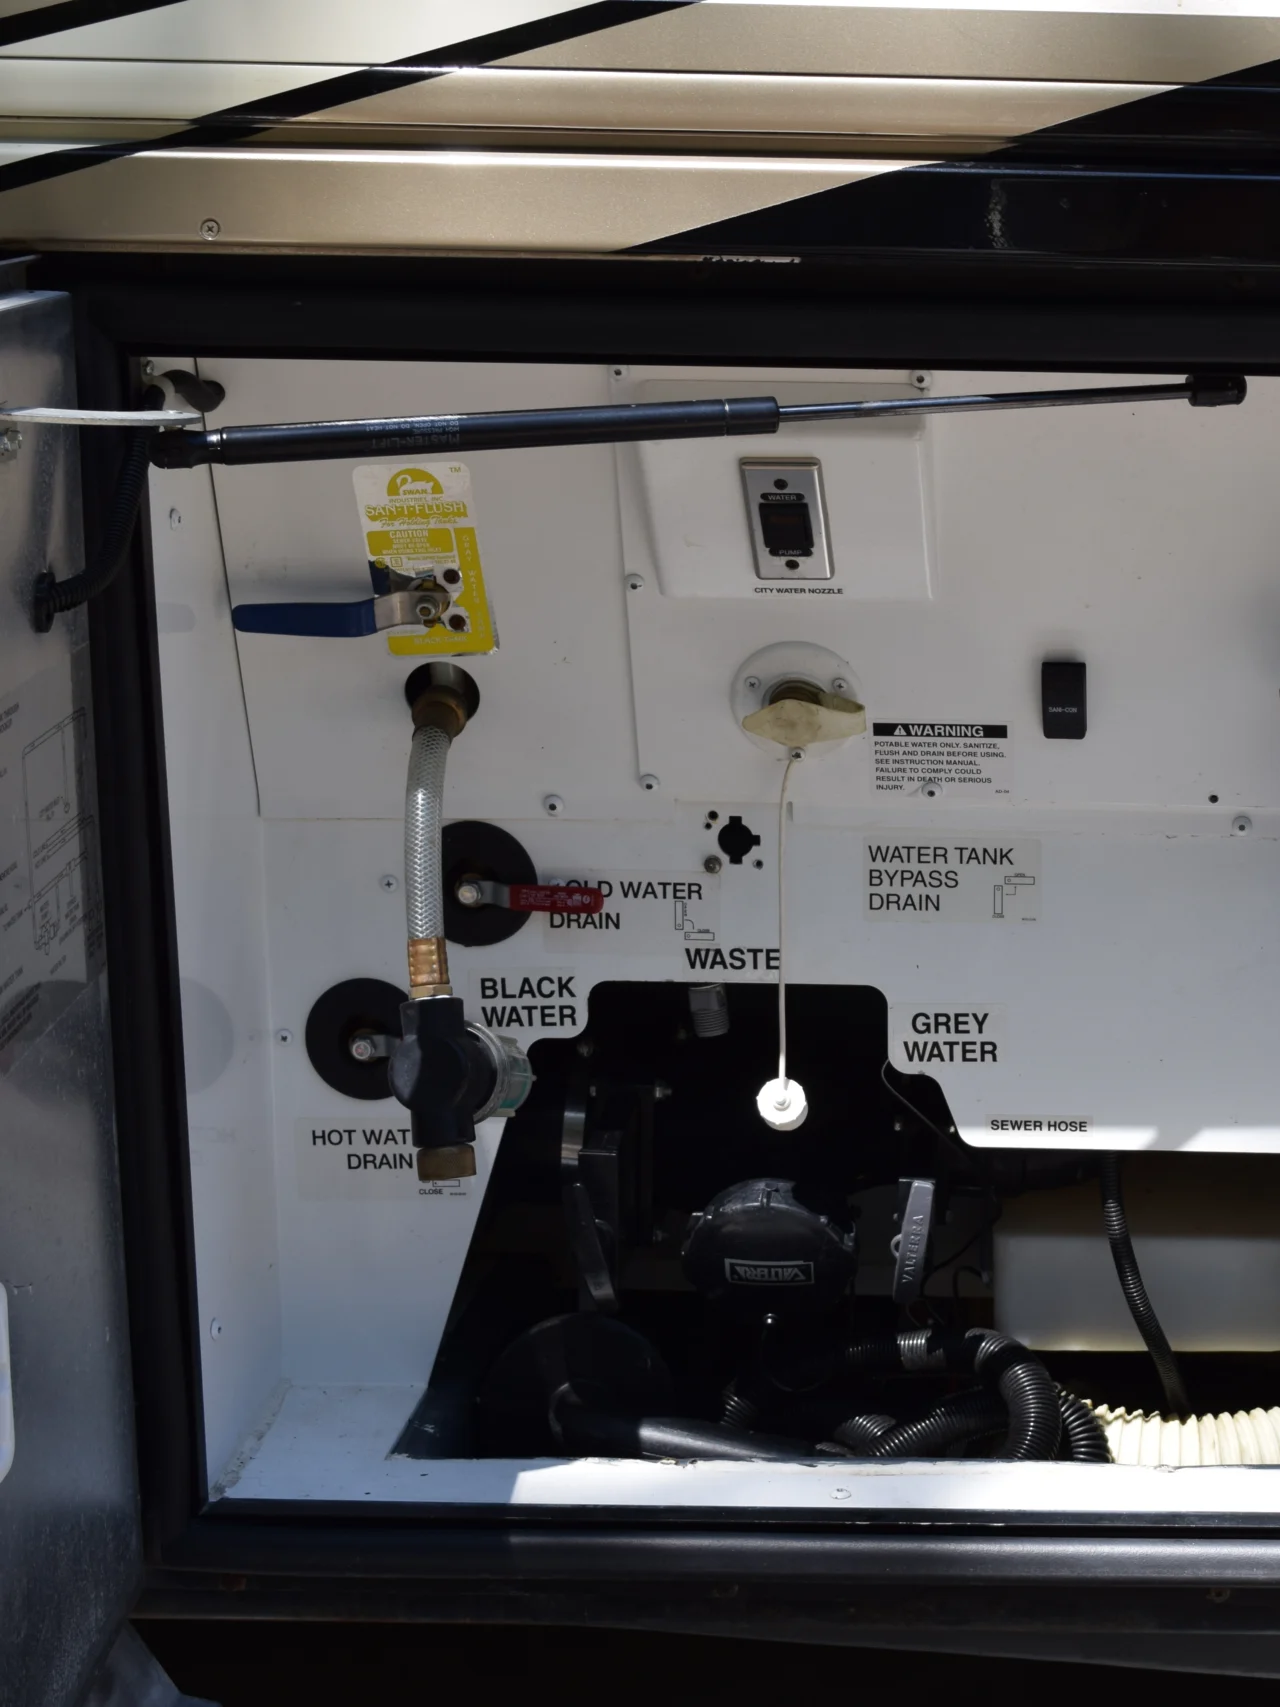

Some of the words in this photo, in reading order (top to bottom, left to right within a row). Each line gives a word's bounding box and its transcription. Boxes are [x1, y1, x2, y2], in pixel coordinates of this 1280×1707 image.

[402, 488, 428, 496] SWAN
[389, 529, 429, 539] CAUTION
[807, 588, 844, 596] NOZZLE
[908, 725, 984, 737] WARNING
[910, 741, 938, 749] WATER
[868, 845, 949, 864] WATER
[954, 847, 1014, 866] TANK
[869, 869, 959, 889] BYPASS
[619, 880, 703, 901] WATER
[869, 893, 940, 912] DRAIN
[550, 912, 620, 930] DRAIN
[685, 948, 780, 970] WASTE
[480, 976, 577, 999] BLACK
[481, 1005, 577, 1028] WATER
[911, 1012, 989, 1035] GREY
[903, 1041, 998, 1063] WATER
[990, 1119, 1043, 1132] SEWER
[1048, 1121, 1087, 1133] HOSE
[311, 1129, 356, 1146] HOT
[362, 1129, 411, 1146] WAT
[347, 1153, 413, 1170] DRAIN
[902, 1214, 925, 1284] VALTERRA
[733, 1264, 806, 1281] VALTERRA
